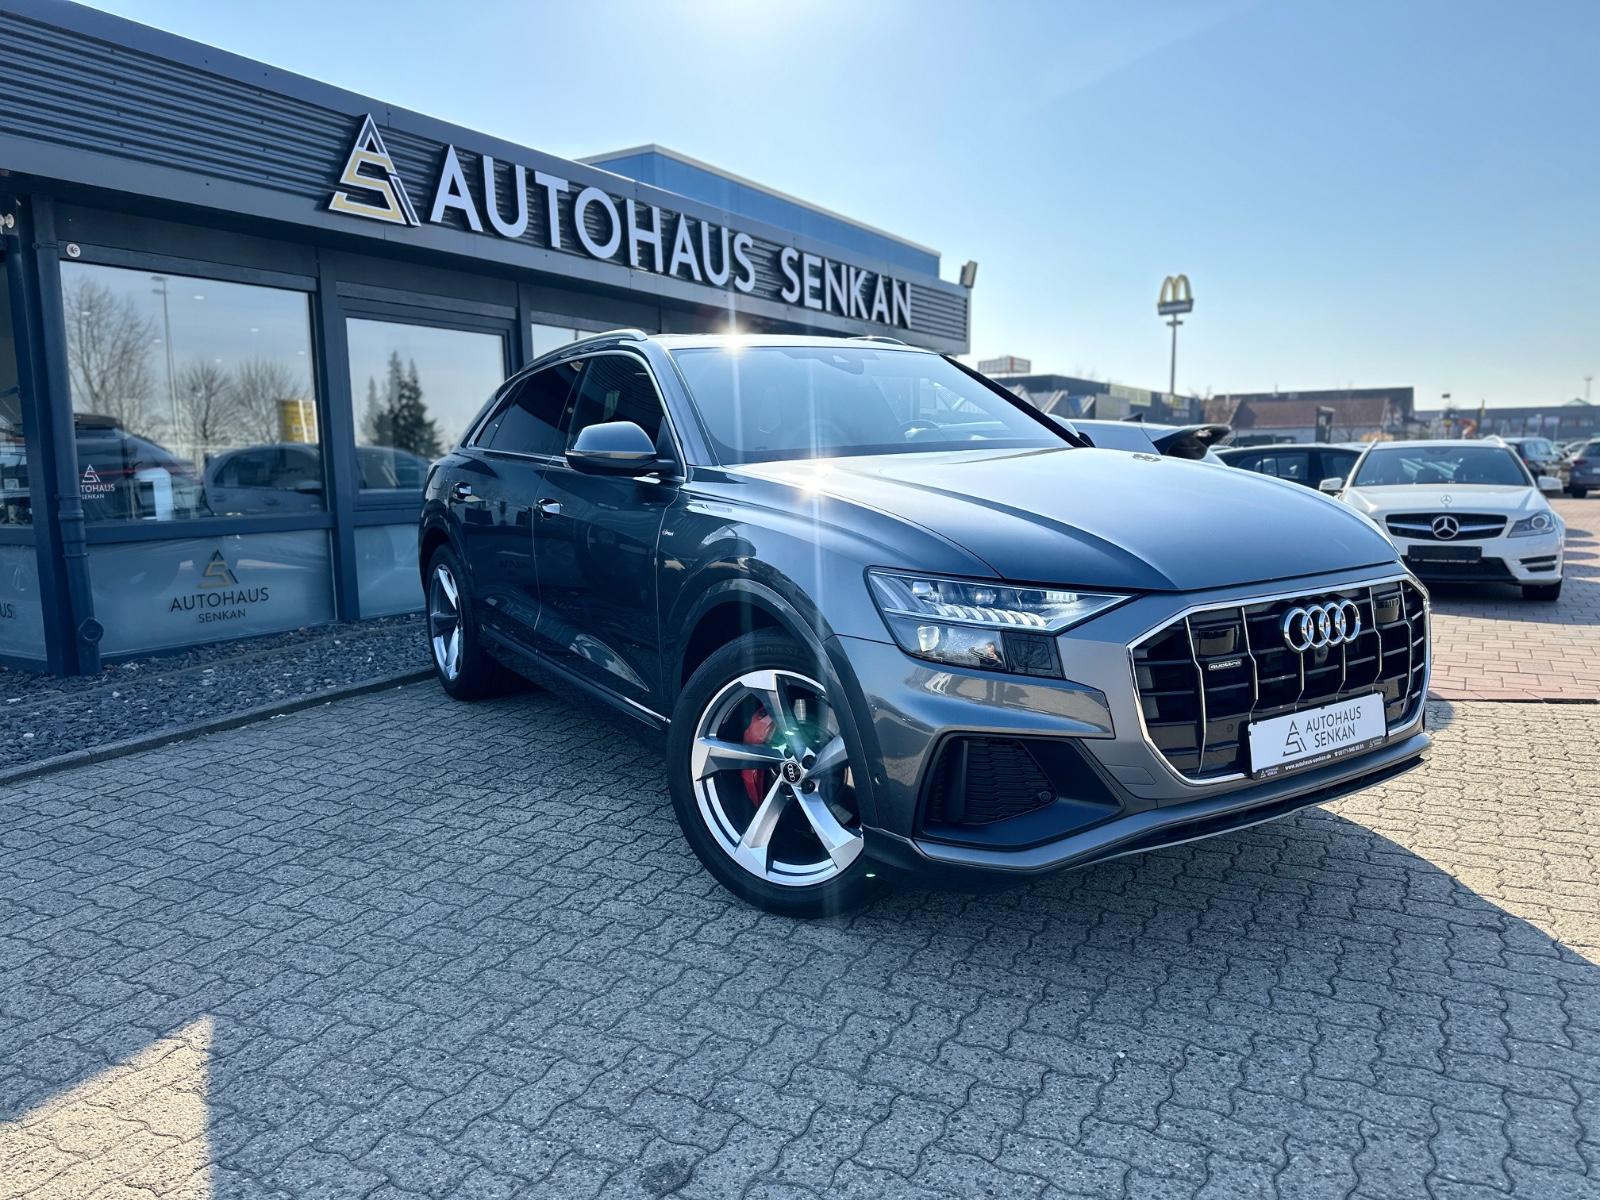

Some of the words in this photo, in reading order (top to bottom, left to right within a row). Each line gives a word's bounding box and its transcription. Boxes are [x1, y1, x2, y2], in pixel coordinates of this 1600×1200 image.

[430, 143, 756, 293] AUTOHAUS
[780, 246, 912, 329] SENKAN
[80, 483, 116, 493] TOHAUS
[170, 587, 270, 613] AUTOHAUS
[198, 607, 246, 624] SENKAN
[1305, 706, 1362, 734] AUTOHAUS
[1314, 723, 1356, 748] SENKAN
